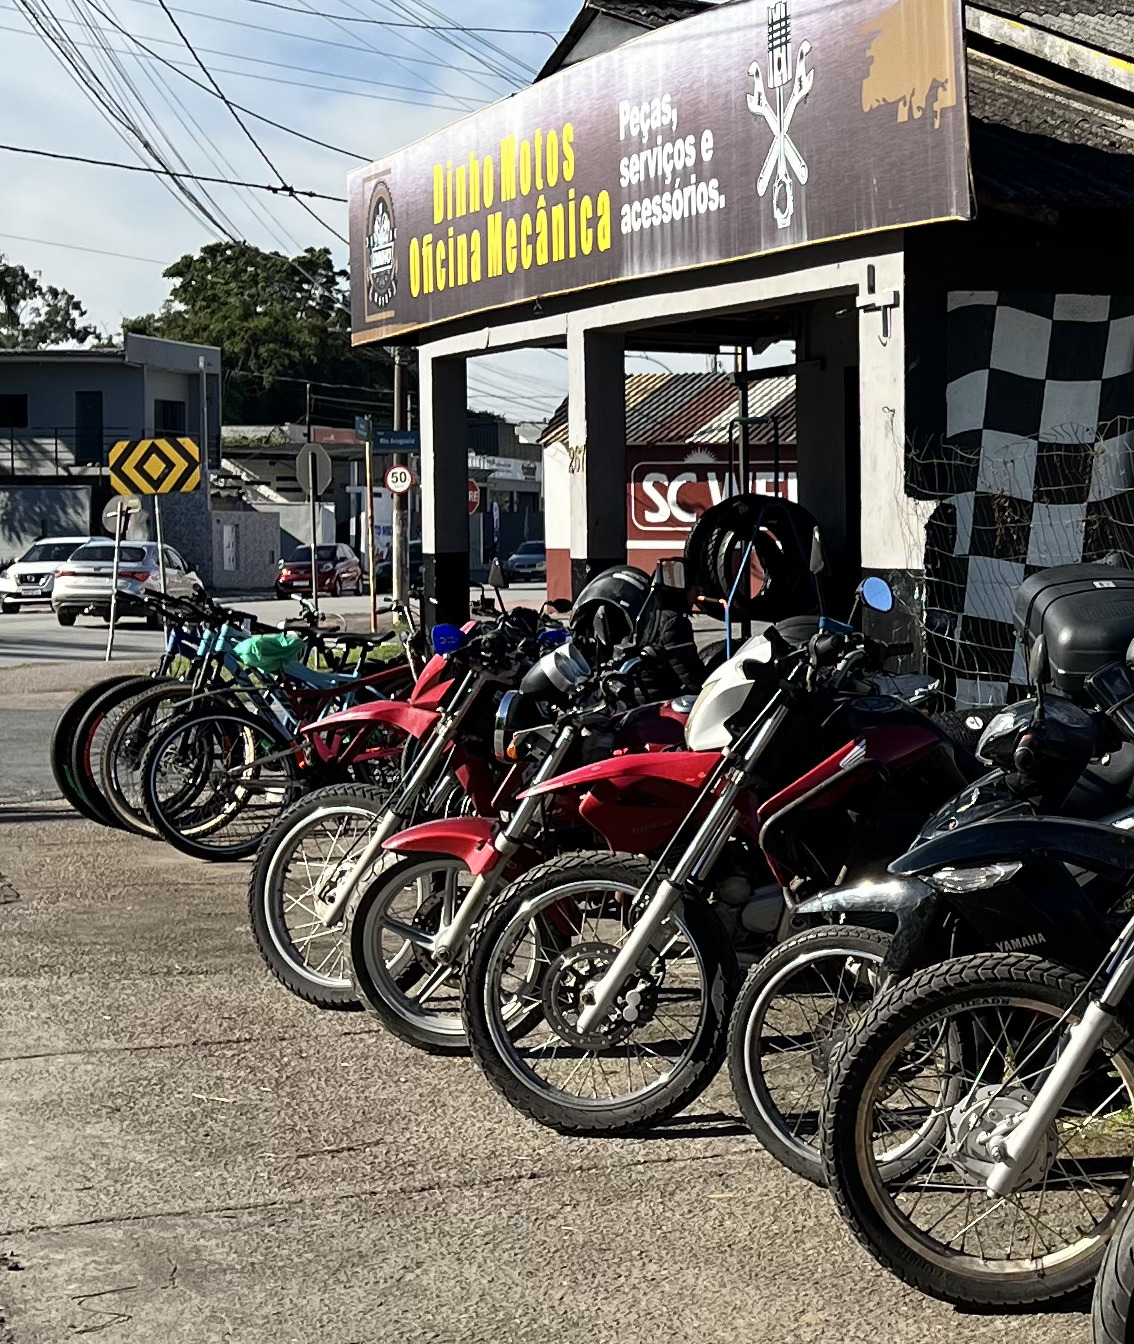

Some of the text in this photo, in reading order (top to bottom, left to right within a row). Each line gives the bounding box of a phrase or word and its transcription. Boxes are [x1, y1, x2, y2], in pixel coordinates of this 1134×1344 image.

[619, 93, 678, 143] Peças,
[433, 122, 575, 224] Dinho Motos
[619, 129, 714, 185] serviços e
[620, 173, 726, 235] acessórios.
[409, 188, 611, 297] Oficina Mecânica
[391, 471, 407, 484] 50
[642, 472, 697, 523] SC
[995, 932, 1047, 953] YAMAHA
